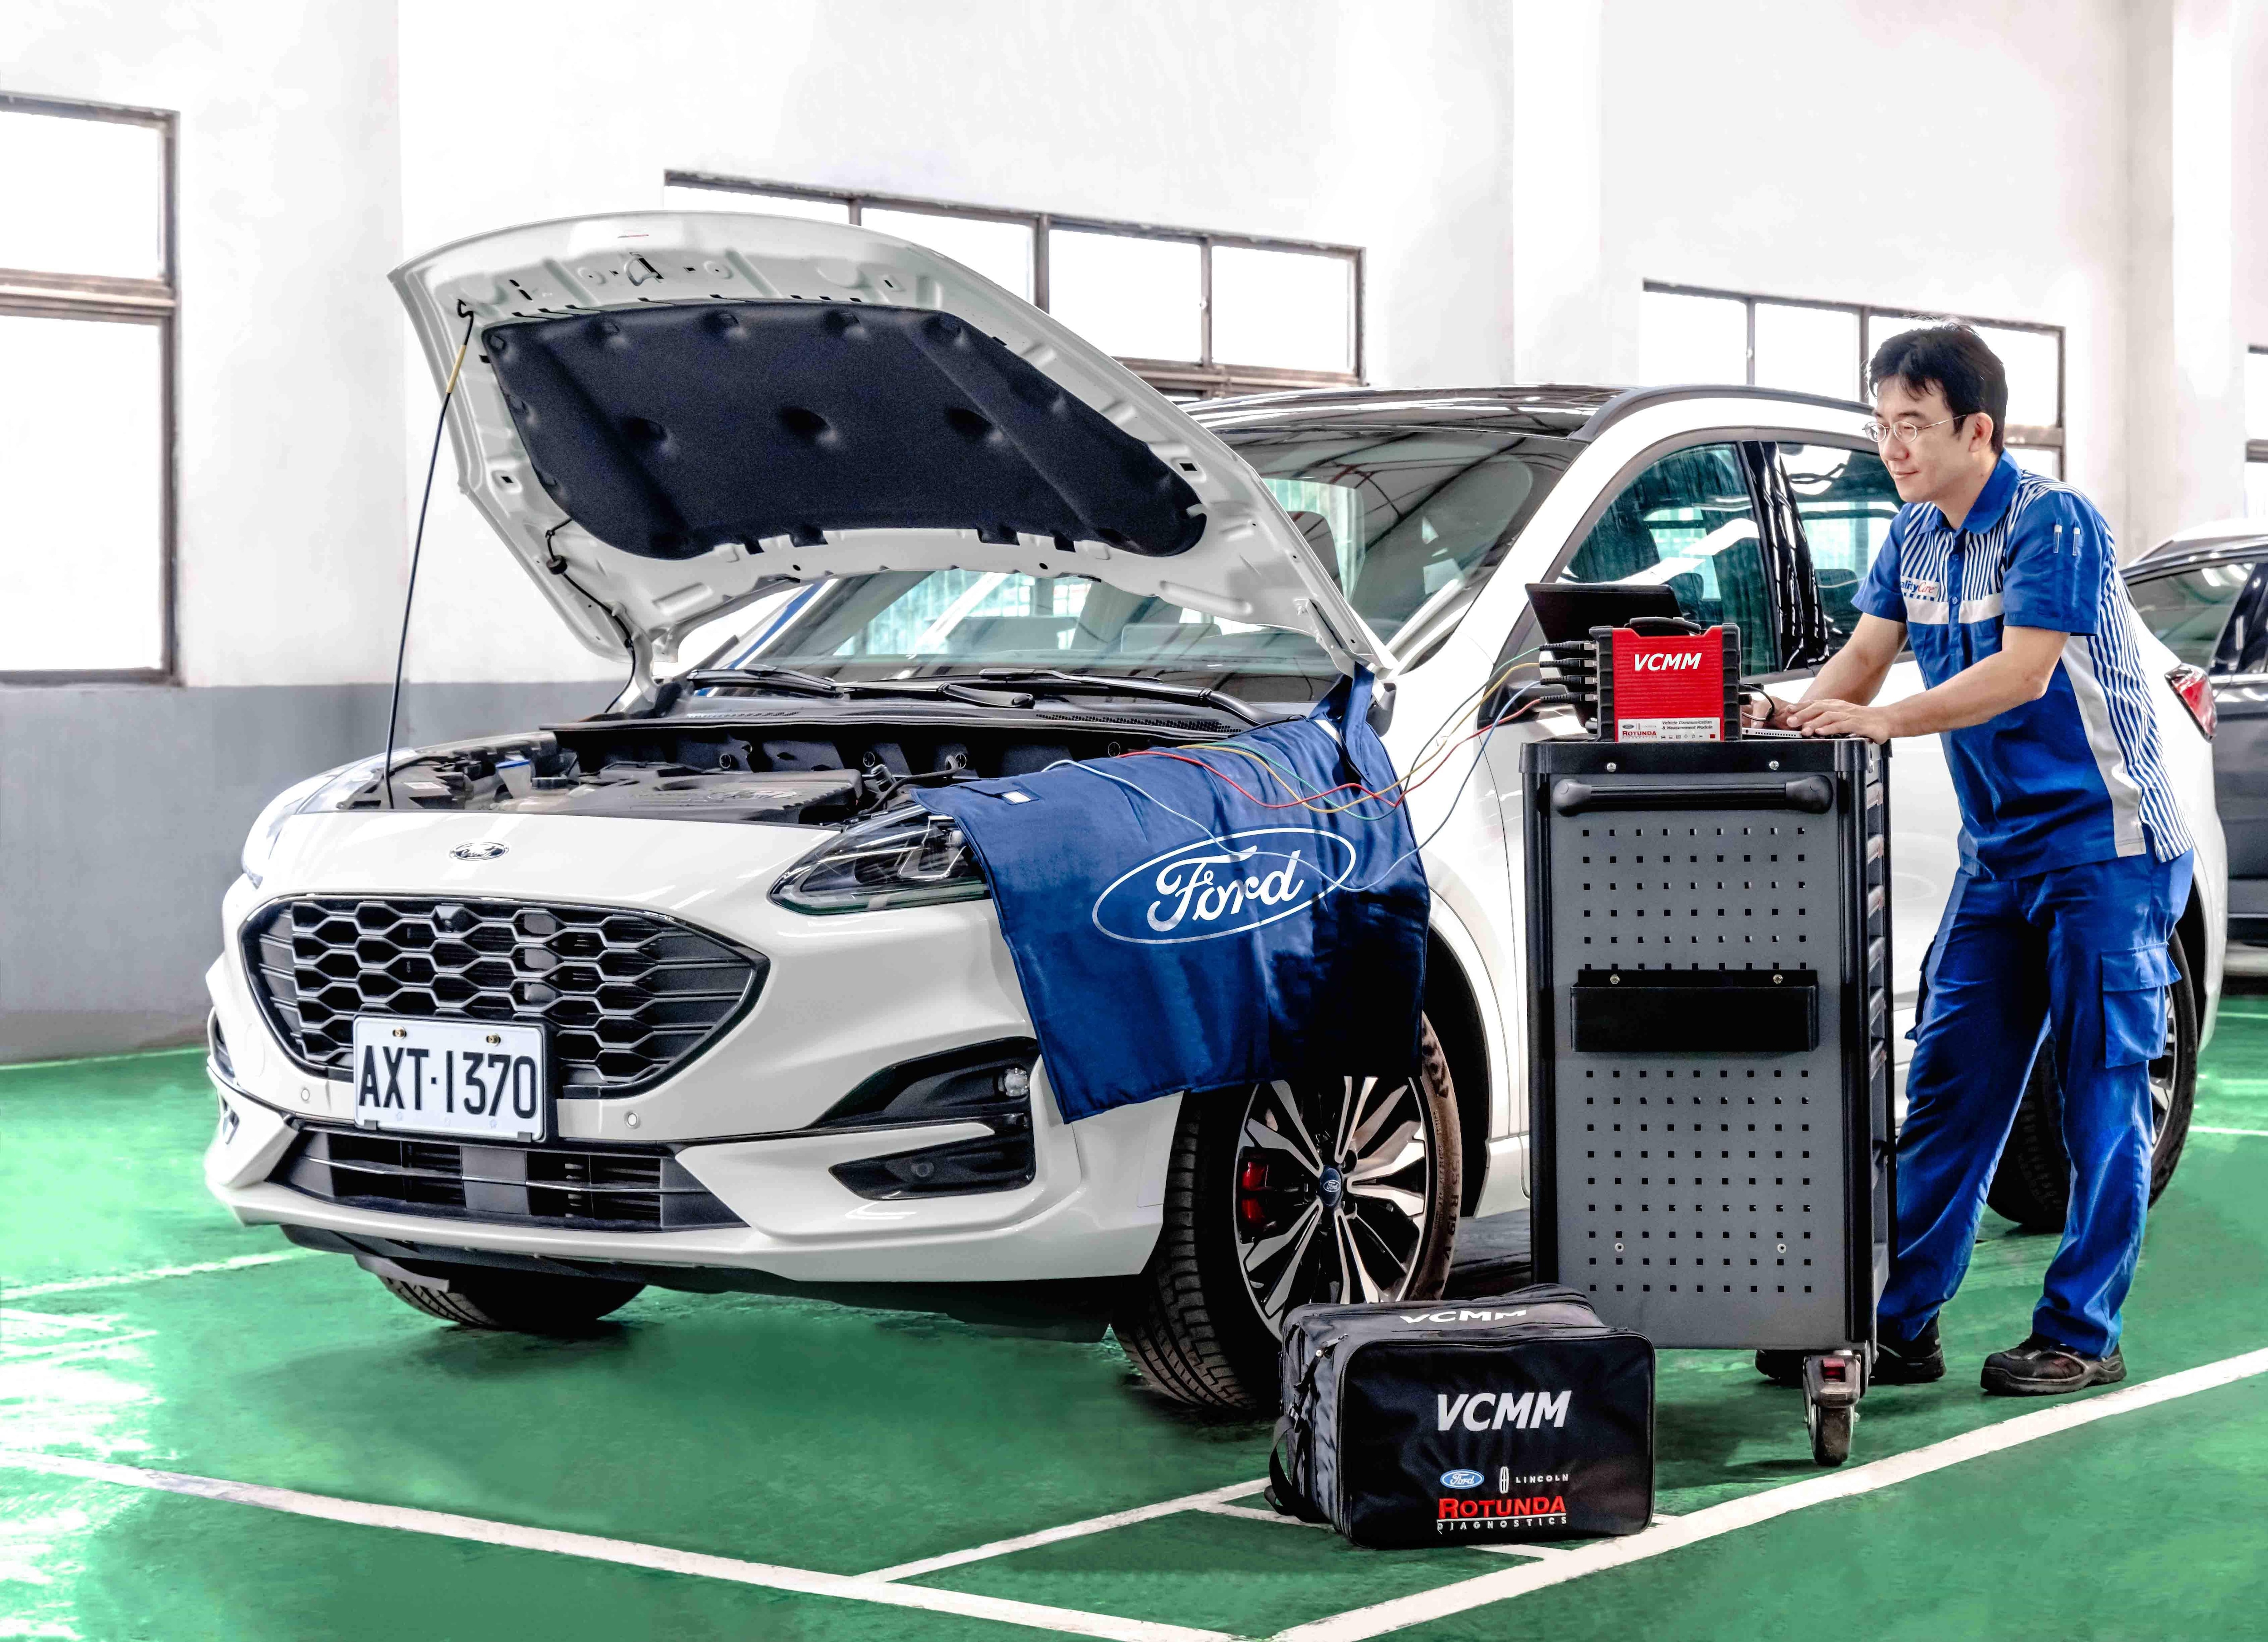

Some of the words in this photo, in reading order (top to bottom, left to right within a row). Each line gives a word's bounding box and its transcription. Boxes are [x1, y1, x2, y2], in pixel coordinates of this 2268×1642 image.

[1901, 580, 1935, 593] alityCare
[1634, 653, 1702, 671] VCMM
[1147, 845, 1305, 932] Ford
[1400, 1310, 1526, 1323] VCMM
[1437, 1390, 1572, 1432] VCMM
[1449, 1473, 1475, 1485] Ford
[1515, 1474, 1569, 1484] LINCOLN
[1438, 1496, 1567, 1519] ROTUNDA
[1437, 1516, 1567, 1531] DIAGNOSTICS
